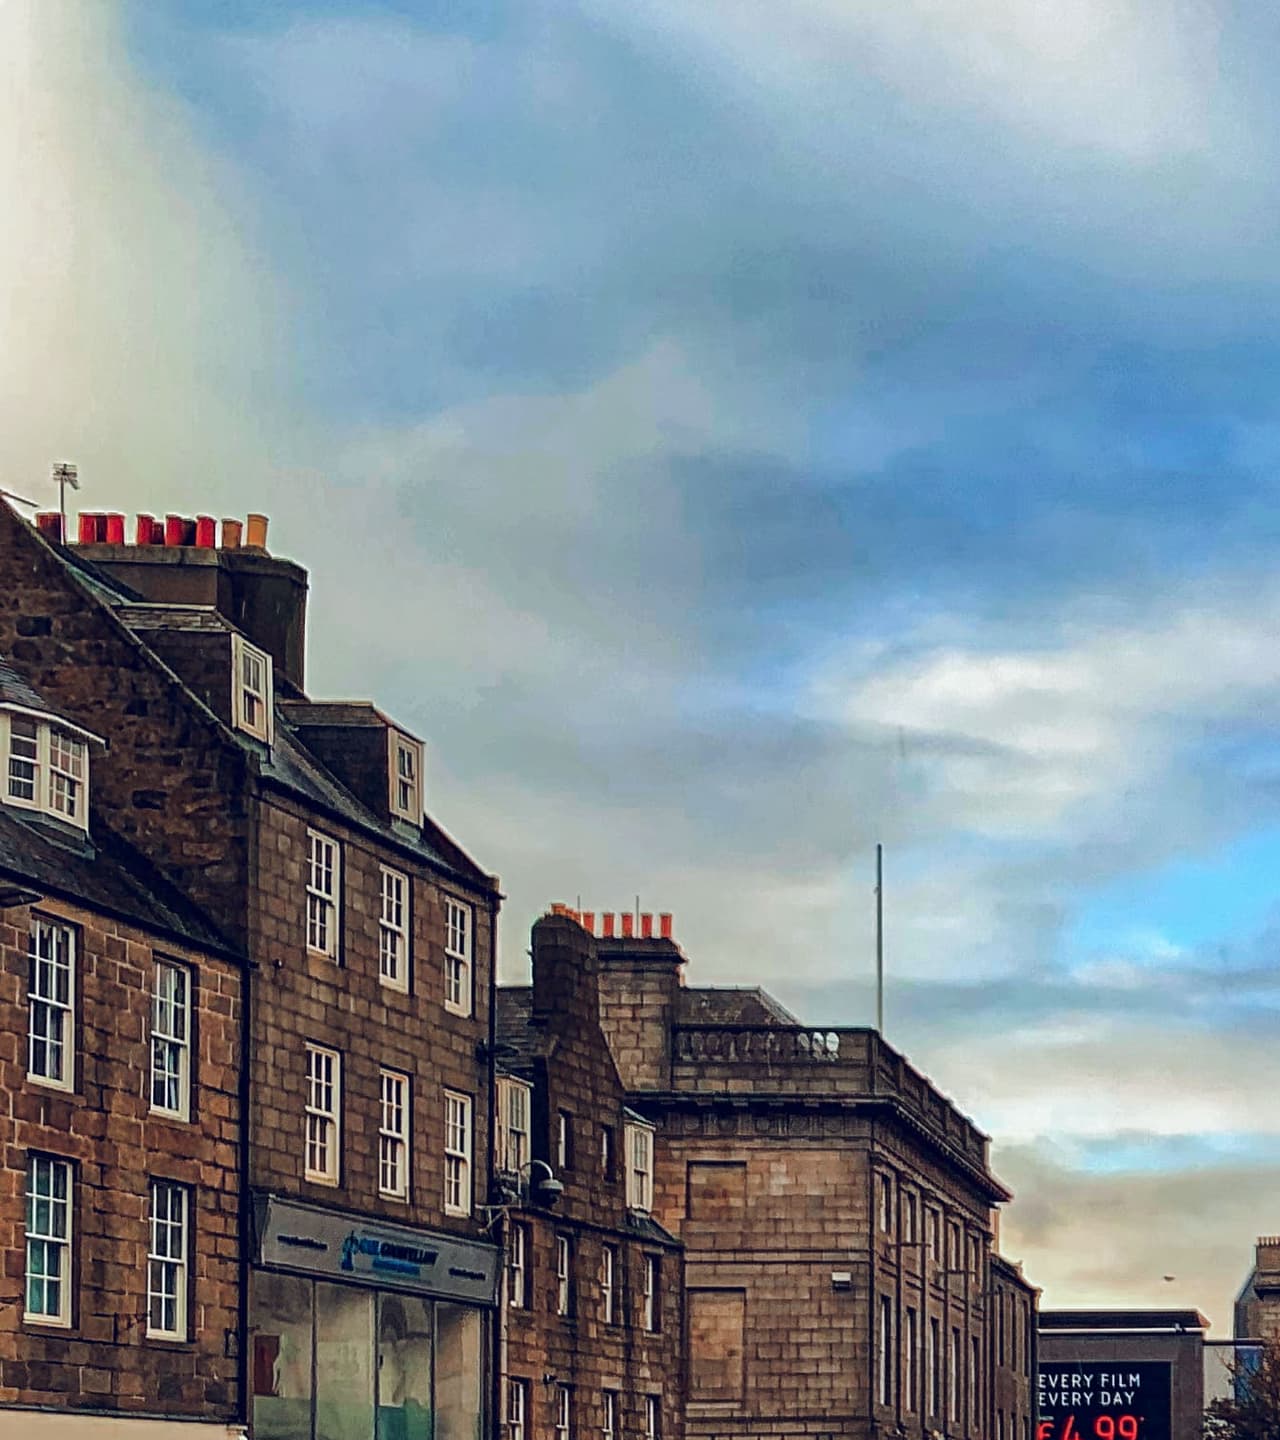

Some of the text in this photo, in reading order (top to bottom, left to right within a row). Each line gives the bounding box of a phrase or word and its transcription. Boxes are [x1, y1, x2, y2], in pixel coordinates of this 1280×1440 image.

[1039, 1373, 1140, 1388] EVERY FILM
[1039, 1391, 1135, 1406] EVERY DAY
